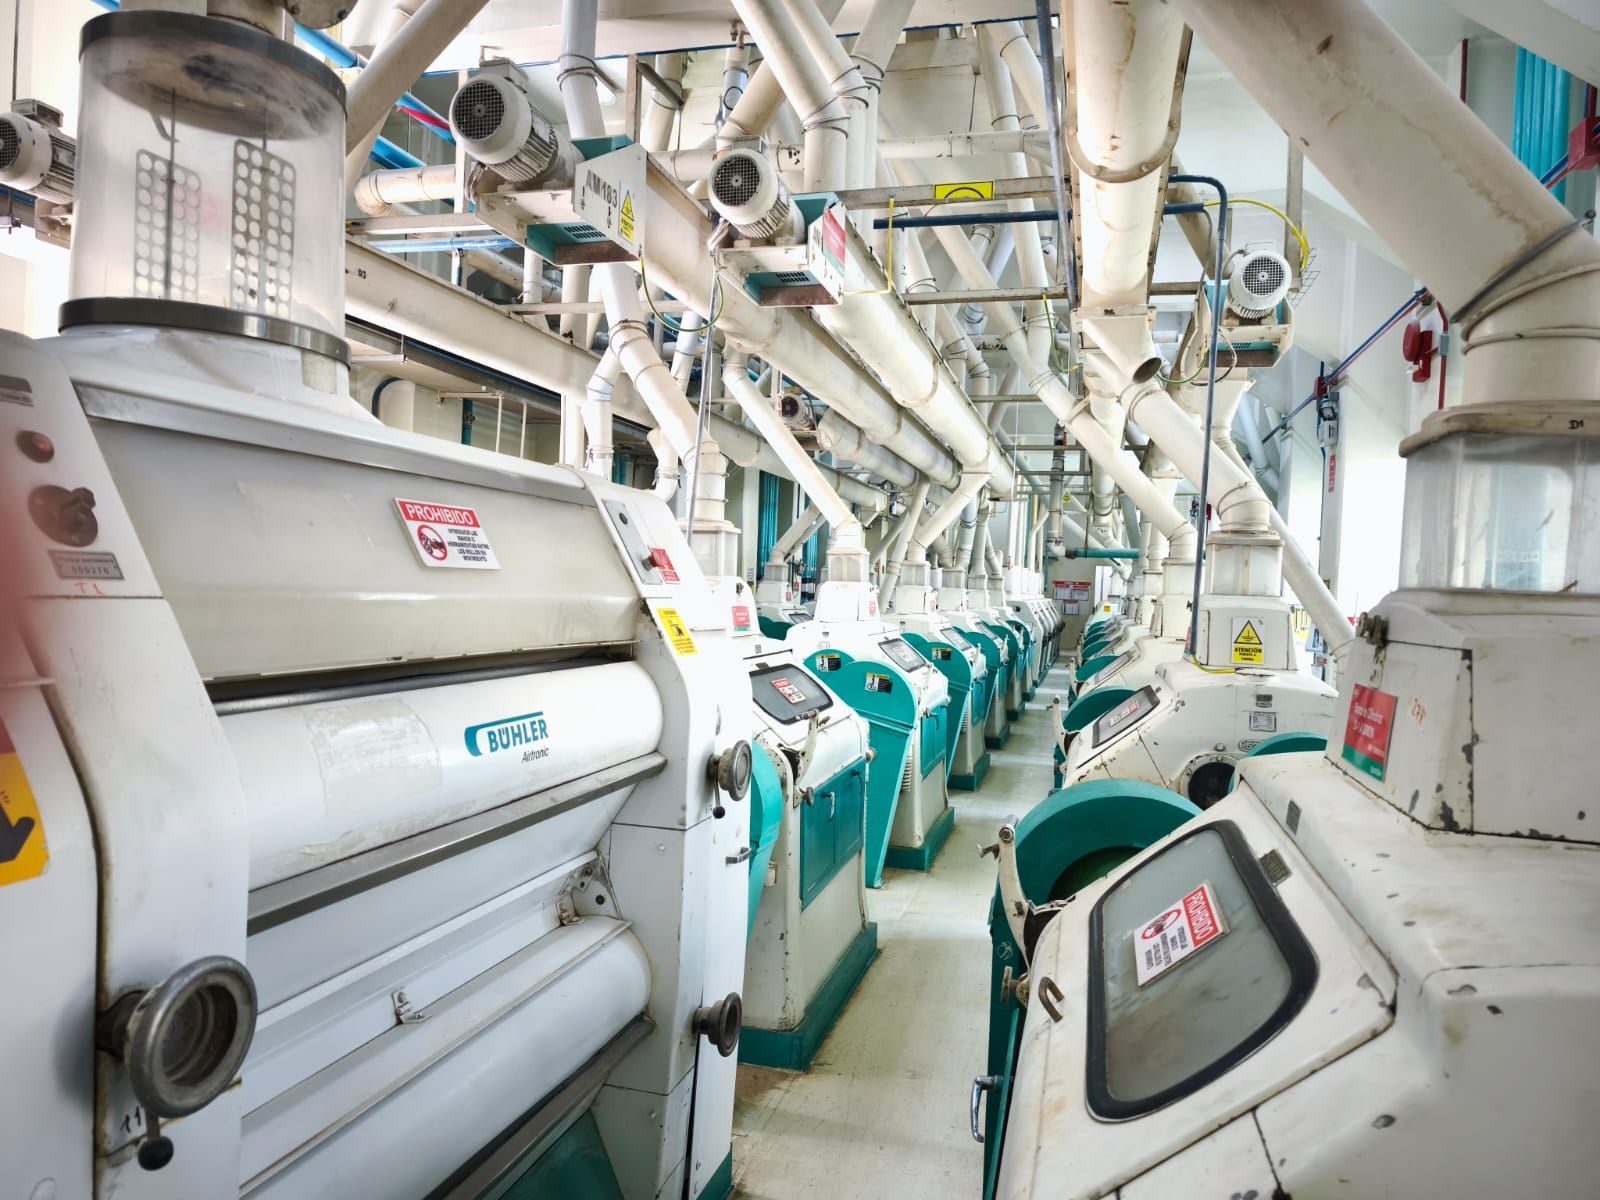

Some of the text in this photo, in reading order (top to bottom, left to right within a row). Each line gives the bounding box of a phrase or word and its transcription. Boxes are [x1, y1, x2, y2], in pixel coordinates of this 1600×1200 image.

[586, 169, 618, 209] AM183
[404, 503, 474, 525] PROHIBIDO
[487, 718, 549, 753] BÜHLER
[521, 747, 549, 764] Airtronic
[1185, 889, 1214, 940] PROHIBIDO
